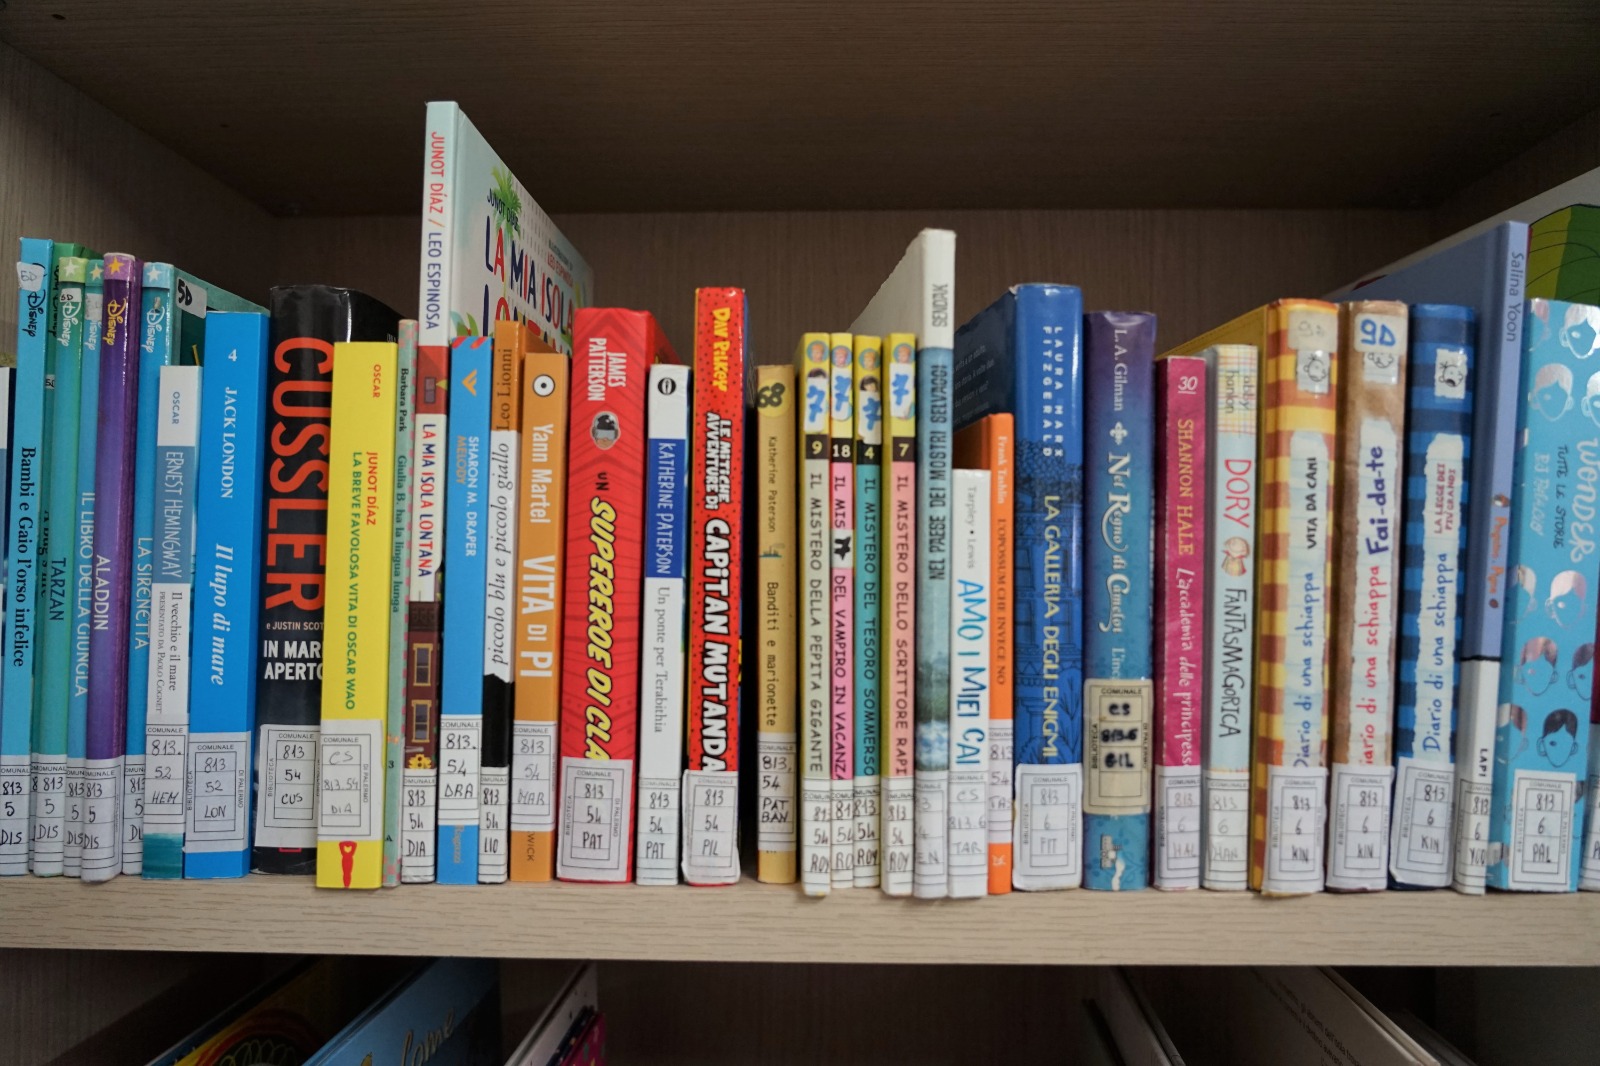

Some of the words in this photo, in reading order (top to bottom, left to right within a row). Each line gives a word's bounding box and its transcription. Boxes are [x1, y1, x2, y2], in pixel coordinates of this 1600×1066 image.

[431, 132, 445, 177] JUNOT
[429, 183, 448, 214] DÍAZ
[428, 233, 442, 258] LEO
[1510, 251, 1524, 296] Salina
[22, 290, 46, 337] Disney
[426, 262, 441, 330] ESPINOSA
[932, 284, 948, 328] SENDAK
[57, 301, 81, 346] Disney
[1506, 302, 1520, 342] Yoon
[228, 349, 238, 362] 4
[588, 338, 606, 401] PATTERSON
[608, 352, 626, 388] JAMES
[1055, 326, 1064, 391] LAURA
[372, 364, 382, 398] OSCAR
[399, 368, 409, 406] Barbara
[930, 364, 948, 424] SELVAGGI
[1114, 363, 1128, 412] Gilman
[172, 392, 180, 424] OSCAR
[224, 386, 238, 428] JACK
[497, 402, 510, 432] Leo
[422, 424, 436, 439] LA
[532, 424, 554, 463] Yann
[221, 433, 236, 498] LONDON
[422, 443, 436, 467] MIA
[468, 436, 479, 489] SHARON
[492, 443, 513, 490] giallo
[832, 444, 850, 458] 18
[930, 430, 948, 480] MOSTRI
[1178, 418, 1194, 498] SHANNON
[1556, 444, 1569, 478] TUTTE
[20, 447, 36, 496] Bambi
[165, 451, 184, 496] ERNEST
[266, 337, 334, 611] CUSSLER
[366, 452, 378, 493] JUNOT
[420, 472, 434, 508] ISOLA
[657, 442, 676, 510] KATHERINE
[1307, 457, 1318, 490] CANI
[352, 472, 362, 510] BREVE
[530, 469, 552, 524] Martel
[930, 487, 946, 508] DEI
[966, 487, 977, 524] Tarpley
[1044, 496, 1060, 521] LA
[1224, 459, 1252, 529] DORY
[1306, 493, 1318, 512] DA
[1366, 446, 1389, 555] Fai-da-te
[490, 495, 512, 554] piccolo
[768, 490, 778, 533] Paterson
[1177, 506, 1194, 555] HALE
[18, 516, 34, 554] Gaio
[80, 511, 94, 559] LIBRO
[138, 538, 153, 558] LA
[162, 499, 184, 578] HEMINGWAY
[349, 512, 360, 580] FAVOLOSA
[418, 514, 434, 578] LONTANA
[466, 512, 478, 557] DRAPER
[656, 513, 675, 574] PATERSON
[810, 498, 822, 571] MISTERO
[864, 502, 876, 574] MISTERO
[897, 500, 909, 574] MISTERO
[929, 516, 946, 552] PAESE
[1307, 518, 1318, 550] VITA
[210, 564, 232, 608] lupo
[488, 574, 506, 600] blu
[522, 556, 556, 614] VITA
[587, 497, 618, 670] SUPEREROE
[928, 558, 946, 580] NEL
[1044, 525, 1060, 619] GALLERIA
[49, 558, 66, 621] TARZAN
[78, 564, 92, 618] DELLA
[94, 554, 112, 630] ALADDIN
[135, 564, 152, 650] SIRENETTA
[348, 583, 359, 612] VITA
[767, 582, 780, 632] Banditi
[810, 579, 822, 626] DELLA
[834, 576, 846, 602] DEL
[864, 582, 876, 609] DEL
[896, 582, 908, 630] DELLO
[1358, 566, 1388, 646] schiappa
[1427, 553, 1454, 627] schiappa
[170, 604, 182, 643] vecchio
[213, 612, 232, 632] di
[272, 621, 301, 630] JUSTIN
[654, 610, 666, 643] ponte
[957, 579, 988, 641] AMO
[1176, 568, 1196, 650] L'accademia
[1294, 572, 1320, 647] schiappa
[13, 608, 30, 668] infelice
[263, 640, 278, 658] IN
[488, 606, 508, 666] piccolo
[528, 624, 548, 642] DI
[834, 610, 846, 678] VAMPIRO
[864, 619, 876, 680] TESORO
[1433, 636, 1444, 666] una
[74, 623, 90, 698] GIUNGLA
[211, 636, 226, 686] mare
[346, 632, 358, 675] OSCAR
[520, 652, 553, 677] PI
[654, 647, 666, 668] per
[810, 634, 822, 691] PEPITA
[1042, 626, 1060, 680] DEGLI
[1179, 656, 1196, 687] delle
[1302, 657, 1312, 686] una
[766, 654, 780, 726] marionette
[896, 639, 908, 729] SCRITTORE
[957, 667, 986, 717] MIEI
[1365, 657, 1378, 689] una
[1424, 674, 1443, 690] di
[345, 679, 356, 710] WAO
[654, 671, 669, 733] Terabithia
[1356, 698, 1377, 714] di
[278, 732, 314, 740] COMUNALE
[324, 736, 359, 744] COMUNALE
[810, 699, 822, 772] GIGANTE
[864, 688, 876, 776] SOMMERSO
[1042, 686, 1060, 758] ENIGMI
[1422, 698, 1442, 752] Diario
[204, 758, 226, 773] 813
[283, 745, 304, 759] 813
[2, 781, 22, 795] 813
[44, 776, 64, 792] 813
[86, 782, 102, 797] 813
[155, 766, 172, 778] 52
[206, 780, 224, 792] 52
[285, 769, 302, 782] 54
[584, 783, 604, 799] 813
[762, 775, 780, 790] 54
[4, 802, 15, 816] 5
[152, 791, 179, 804] HEM
[204, 804, 226, 818] LON
[282, 793, 303, 804] CUS
[484, 788, 500, 805] 813
[650, 792, 670, 810] 813
[704, 789, 724, 806] 813
[763, 798, 790, 810] PAT
[1424, 784, 1445, 802] 813
[1536, 794, 1556, 812] 813
[586, 806, 602, 824] 54
[704, 814, 718, 832] 54
[1427, 808, 1434, 826] 6
[1538, 816, 1546, 834] 6
[582, 832, 602, 850] PAT
[646, 842, 665, 859] PAT
[702, 839, 718, 856] PIL
[1532, 845, 1552, 864] PAL
